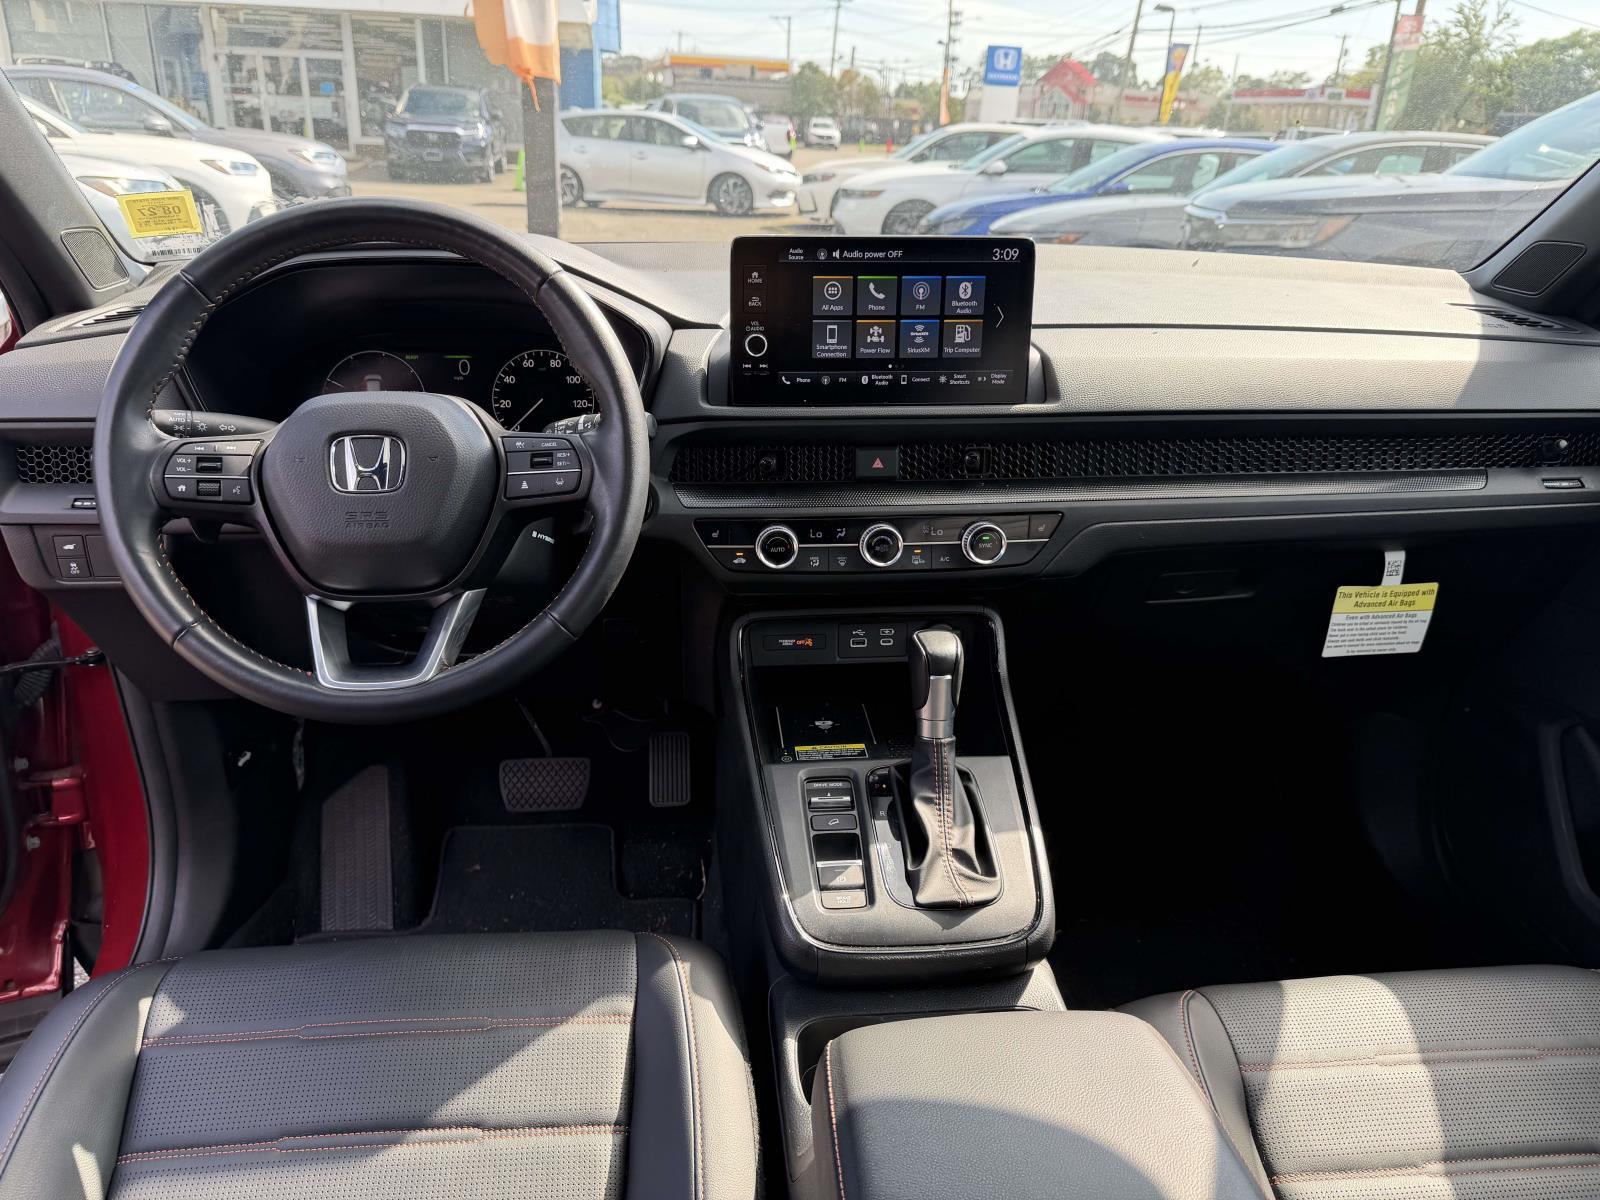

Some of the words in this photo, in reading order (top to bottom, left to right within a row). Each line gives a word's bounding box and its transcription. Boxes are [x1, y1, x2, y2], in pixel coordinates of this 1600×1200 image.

[842, 250, 863, 258] Audio
[864, 251, 886, 260] power
[887, 250, 903, 258] OFF
[992, 248, 1019, 261] 3:09
[830, 304, 844, 312] Apps
[458, 359, 471, 376] 0
[522, 360, 535, 368] 60
[549, 360, 562, 368] 80
[503, 375, 516, 384] 40
[565, 375, 581, 384] 100
[500, 400, 512, 408] 20
[572, 400, 588, 408] 120
[345, 511, 388, 520] SRS
[809, 529, 823, 539] Lo
[931, 526, 944, 536] Lo
[1338, 591, 1353, 599] This
[1354, 590, 1380, 599] Vehicle
[1389, 590, 1420, 599] Equipped
[1421, 588, 1435, 596] with
[1353, 600, 1386, 608] Advanced
[1387, 599, 1398, 607] Air
[1399, 599, 1416, 607] Bags
